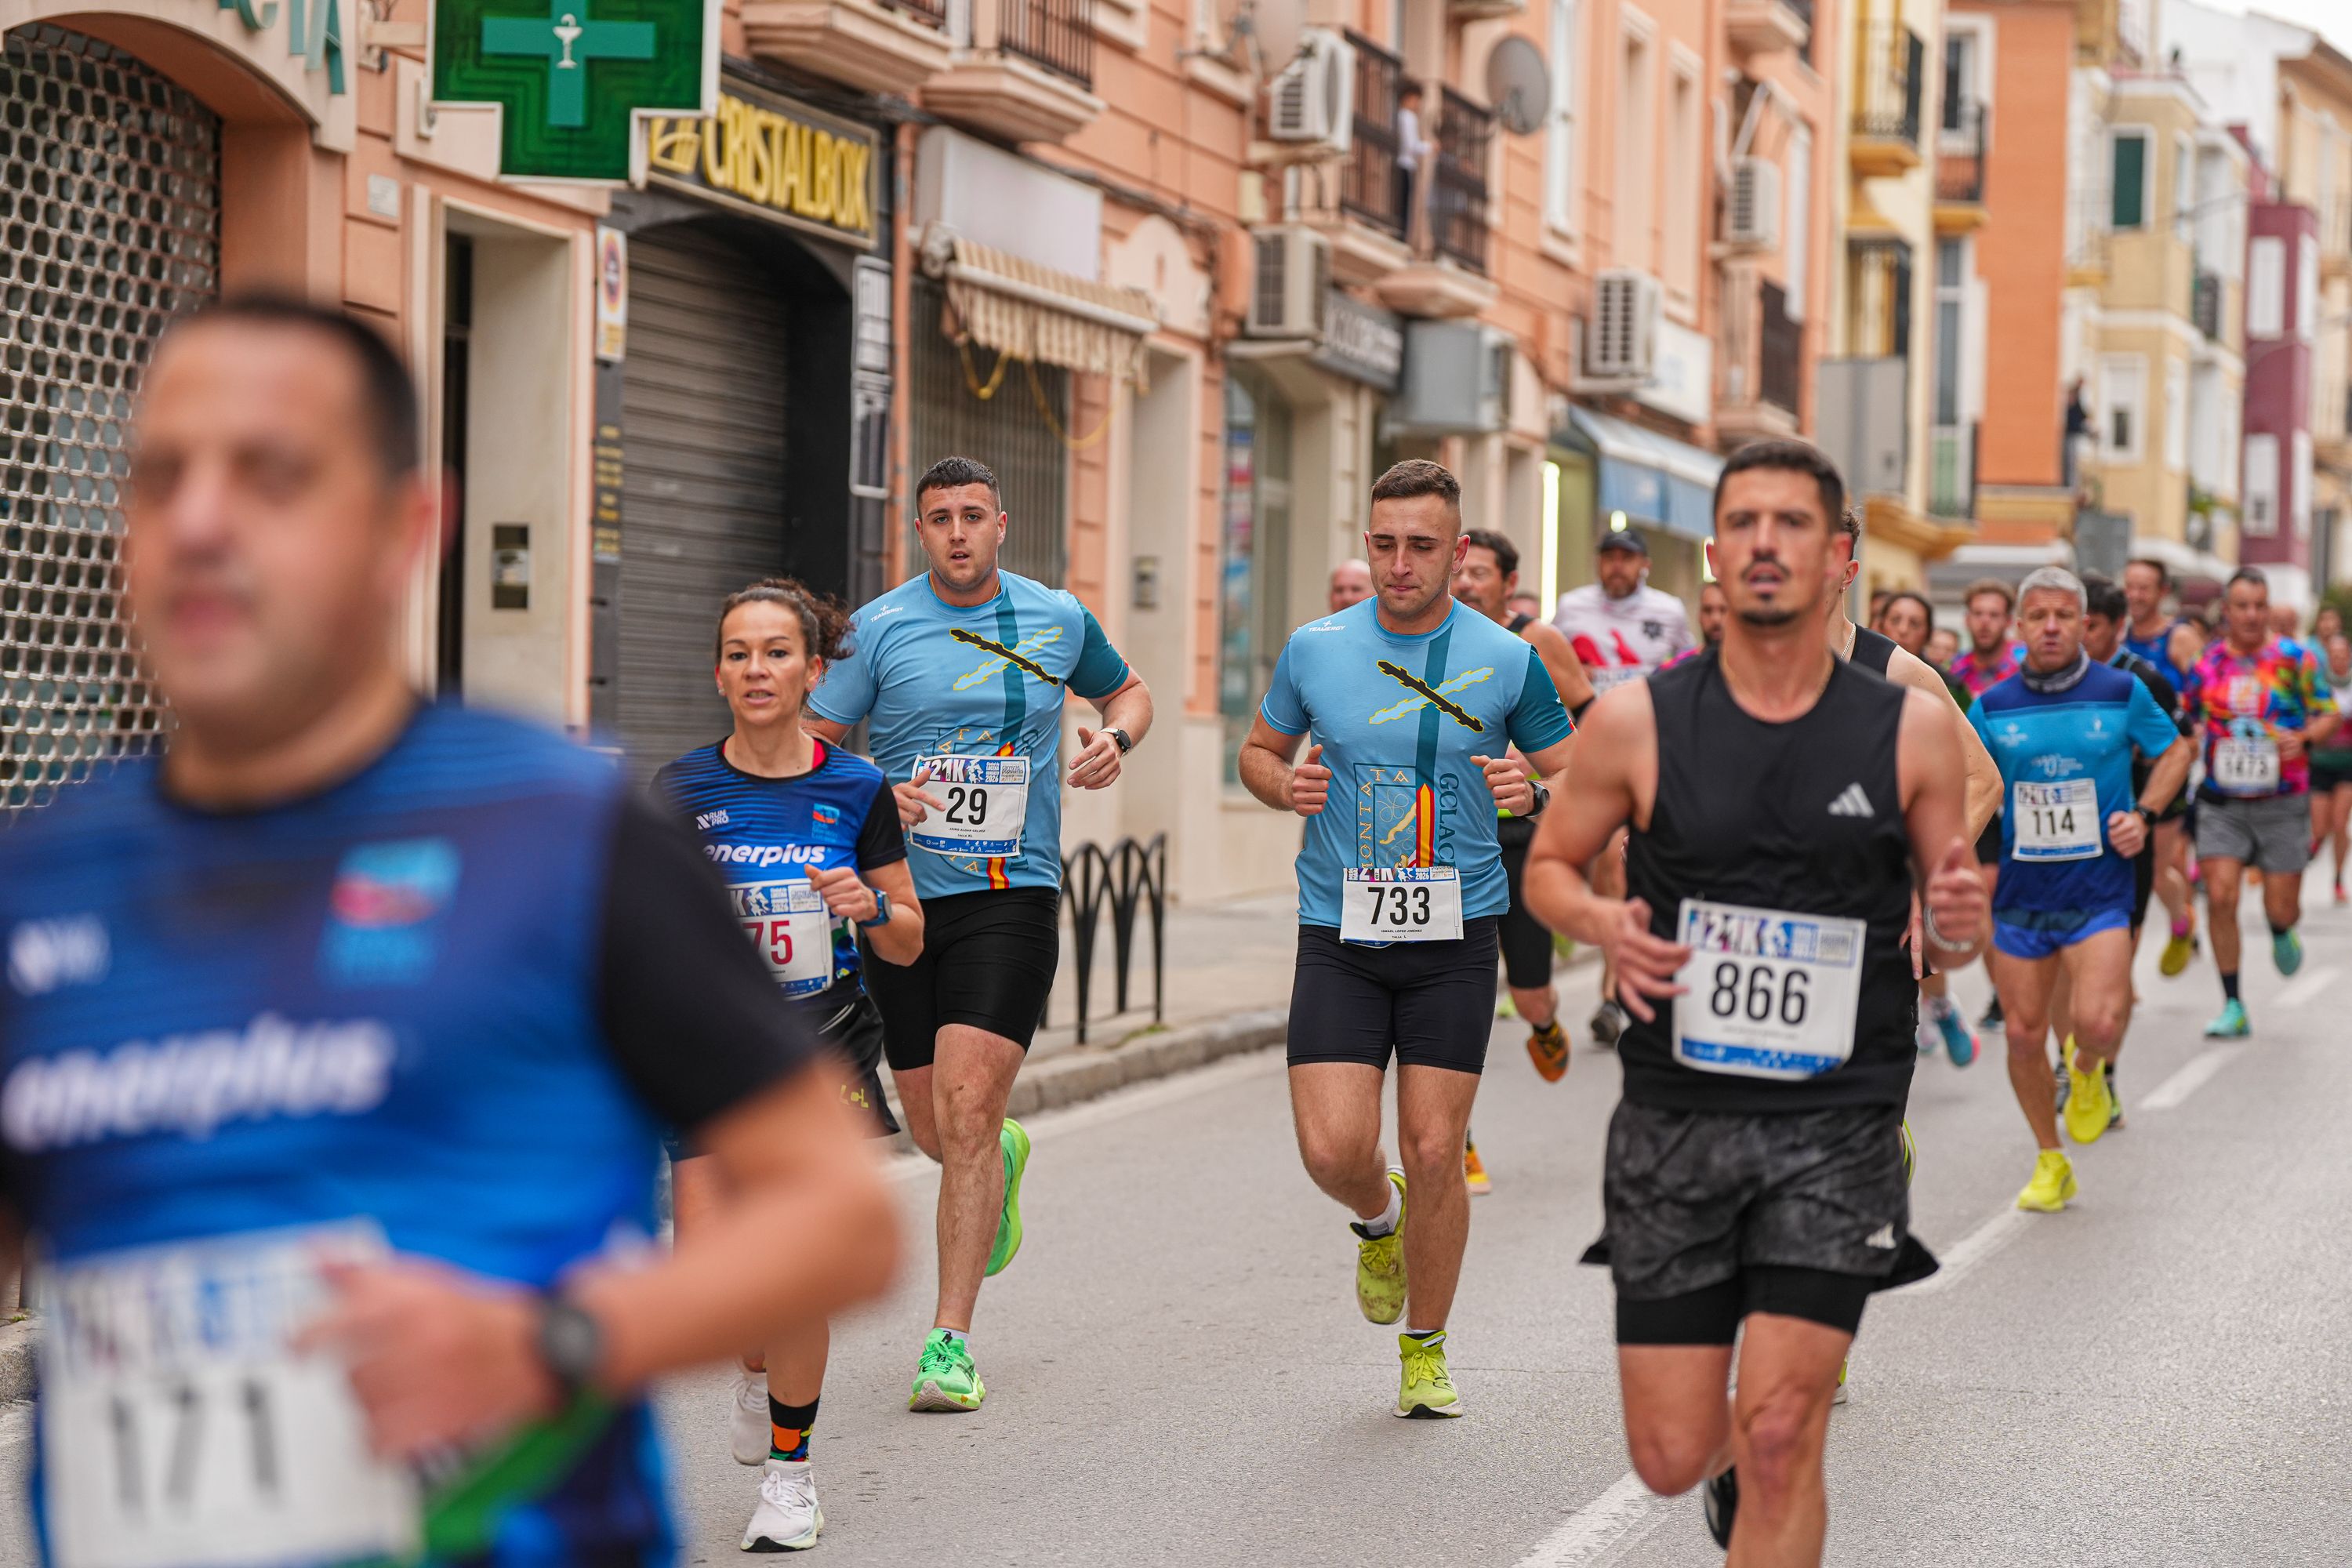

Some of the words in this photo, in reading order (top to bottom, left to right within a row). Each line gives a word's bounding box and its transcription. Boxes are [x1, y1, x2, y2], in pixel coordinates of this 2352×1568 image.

[702, 90, 870, 230] CRISTALBOX
[709, 809, 728, 819] RUN
[711, 815, 730, 826] PRO
[946, 786, 988, 826] 29
[2032, 807, 2075, 836] 114
[703, 843, 826, 868] enerplus
[1367, 886, 1431, 925] 733
[1711, 961, 1811, 1025] 866
